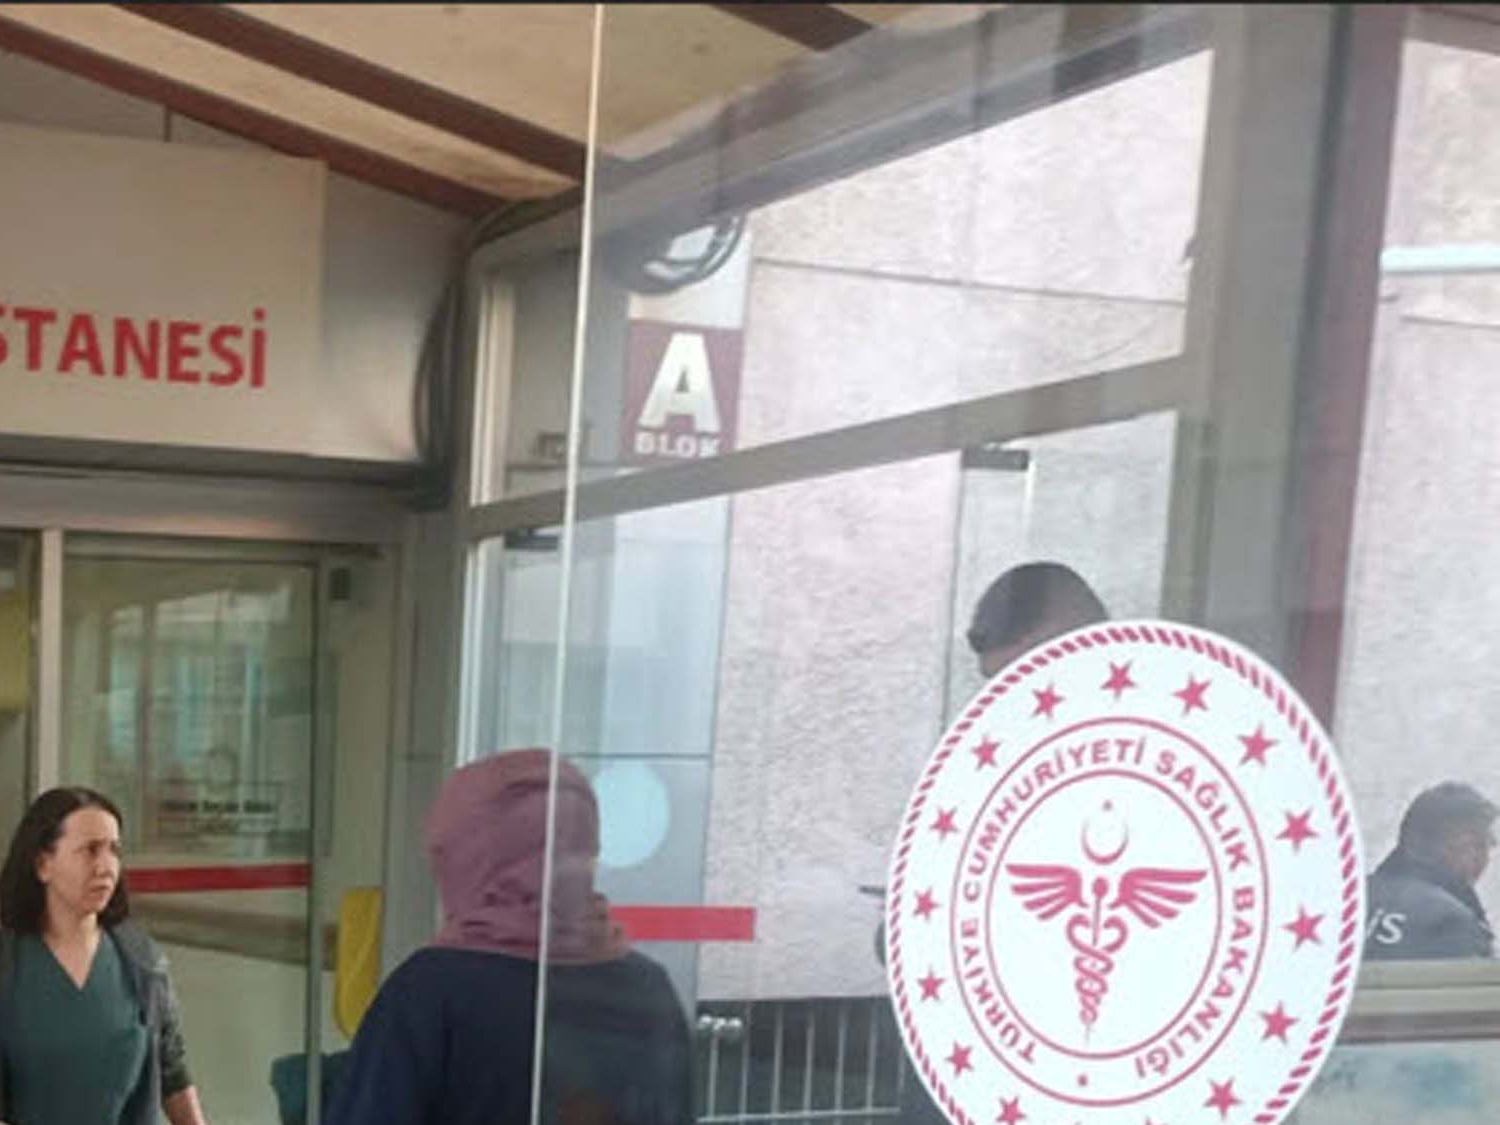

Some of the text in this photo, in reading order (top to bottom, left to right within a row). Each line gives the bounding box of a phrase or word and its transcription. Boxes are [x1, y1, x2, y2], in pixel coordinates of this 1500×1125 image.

[638, 332, 722, 432] A
[960, 735, 1256, 1080] TÜRKİYE CUMHURİYETİ SAĞLIK BAKANLIĞI
